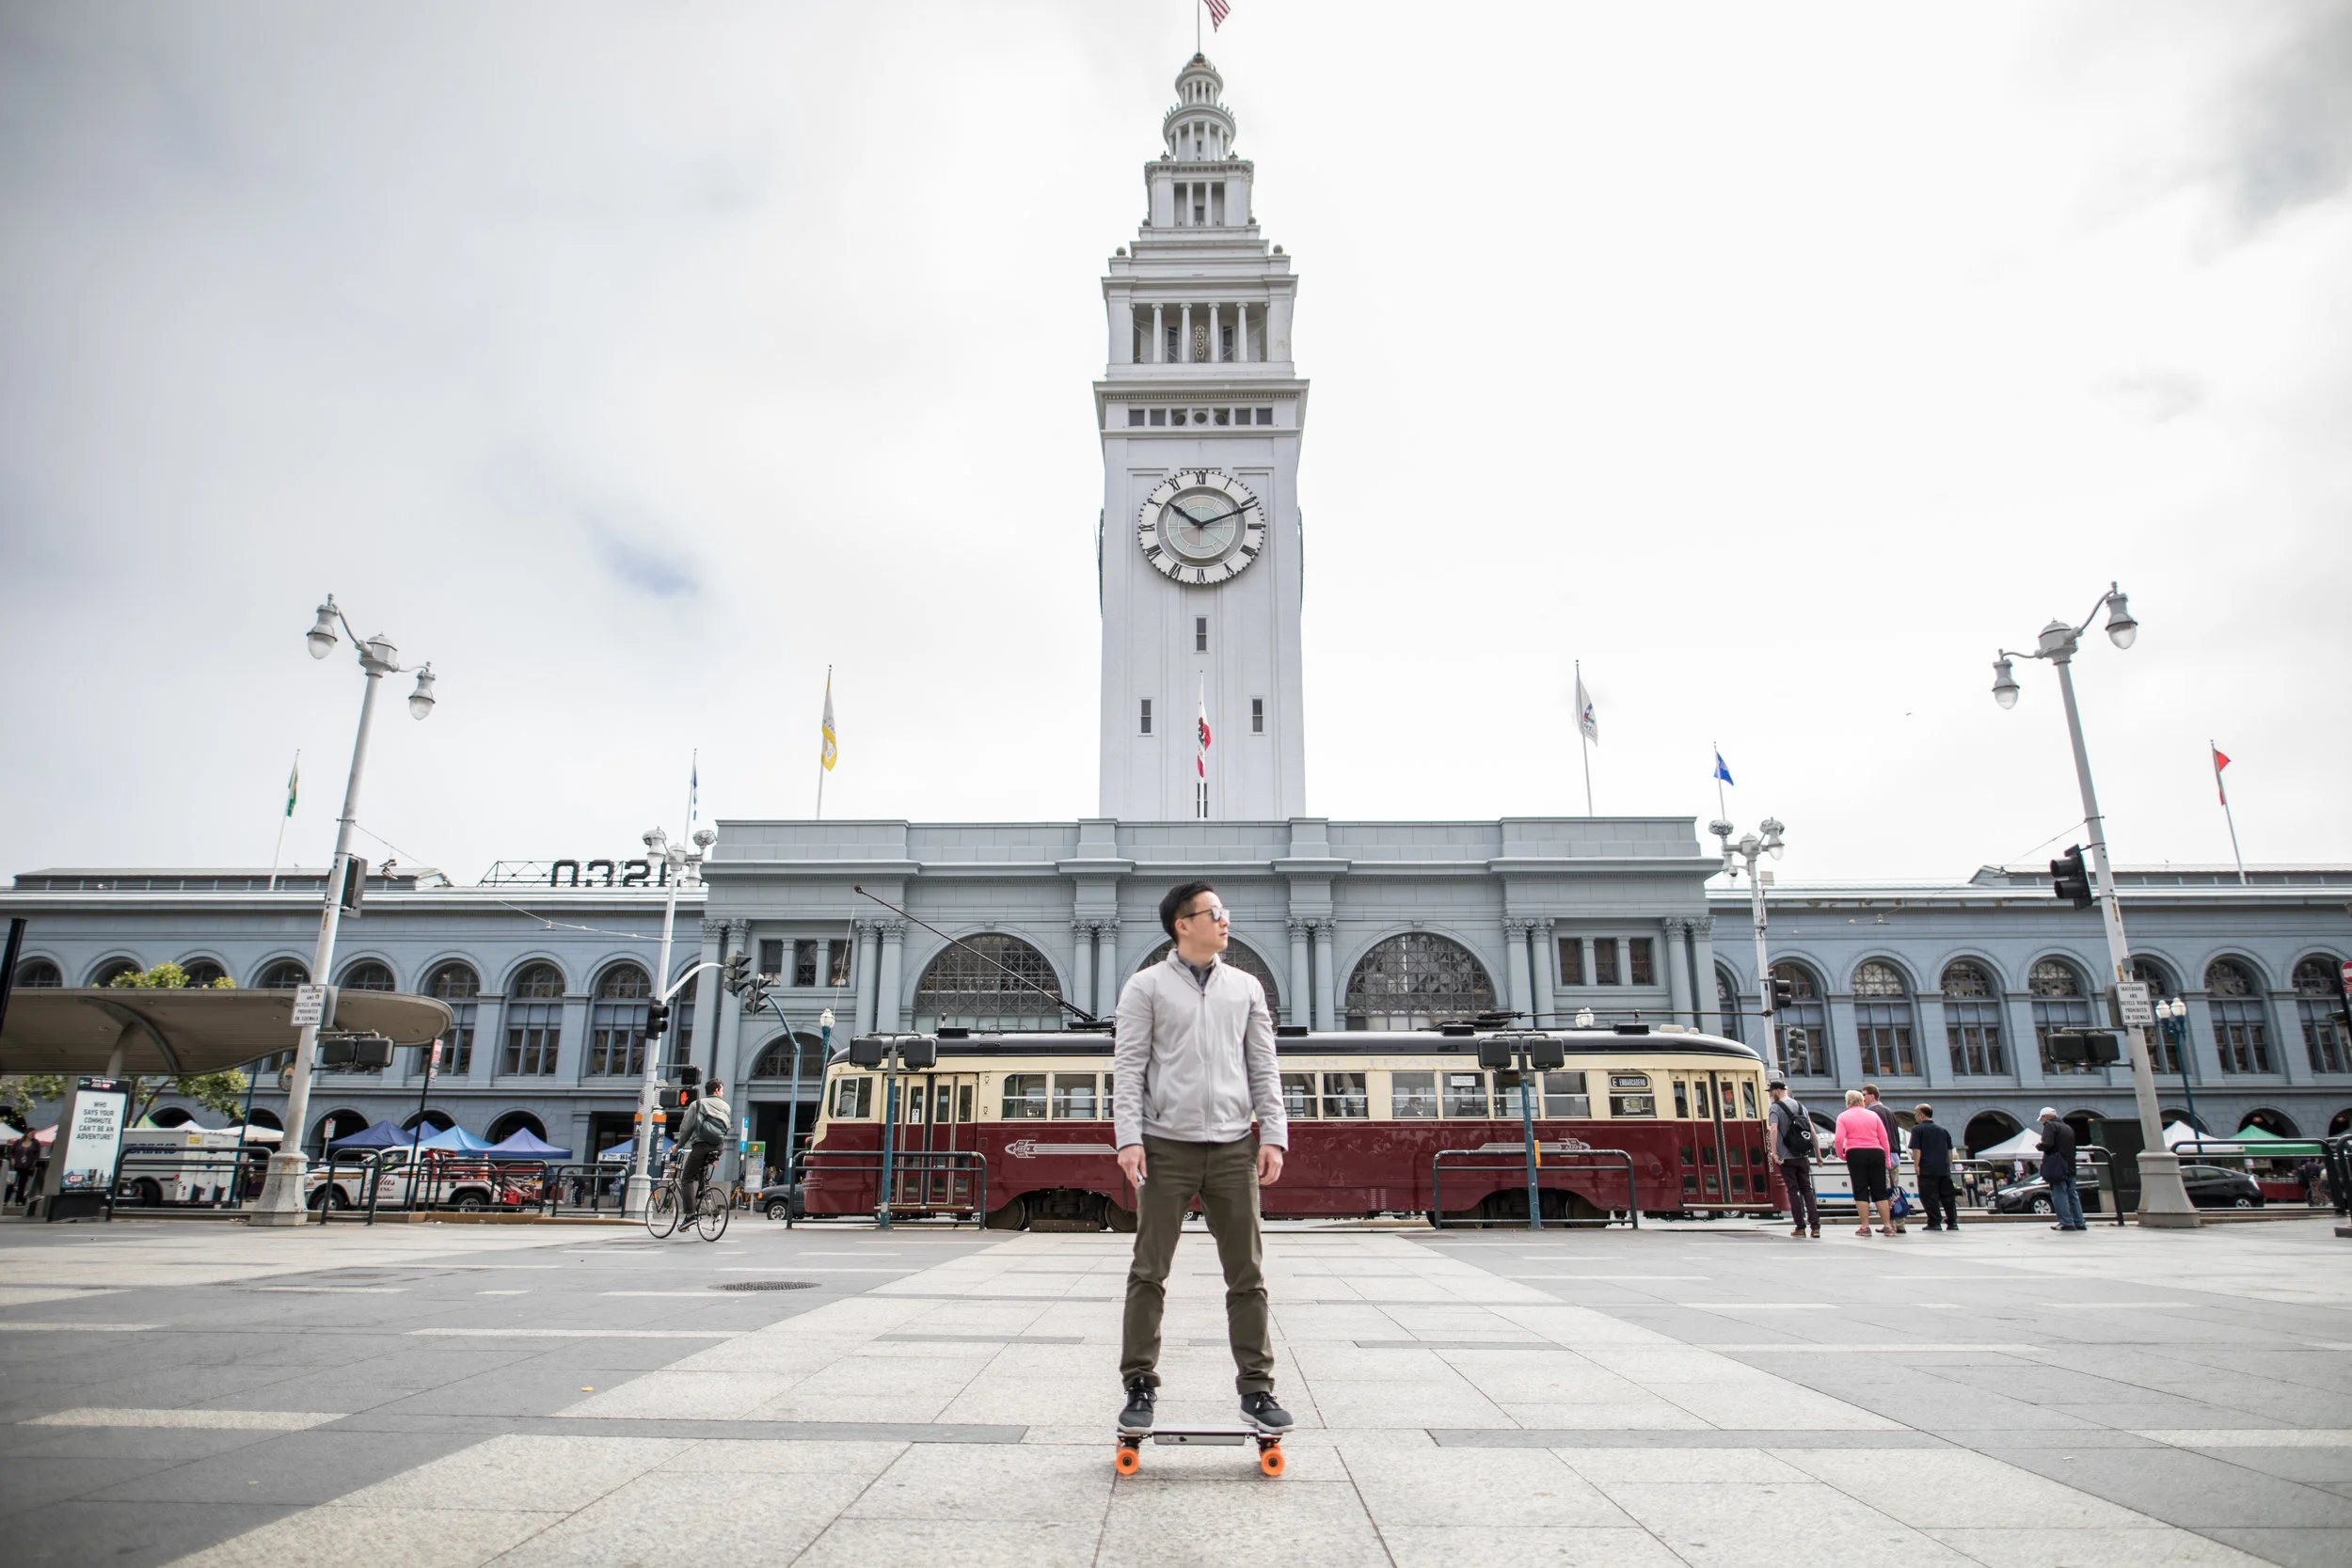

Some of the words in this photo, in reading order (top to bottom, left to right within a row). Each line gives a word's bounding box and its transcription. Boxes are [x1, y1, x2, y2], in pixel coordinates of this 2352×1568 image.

[1196, 471, 1206, 485] XII
[1168, 478, 1182, 493] XI
[1197, 568, 1206, 582] VI
[1613, 1078, 1617, 1086] E
[1619, 1078, 1645, 1086] EMBARCADERO
